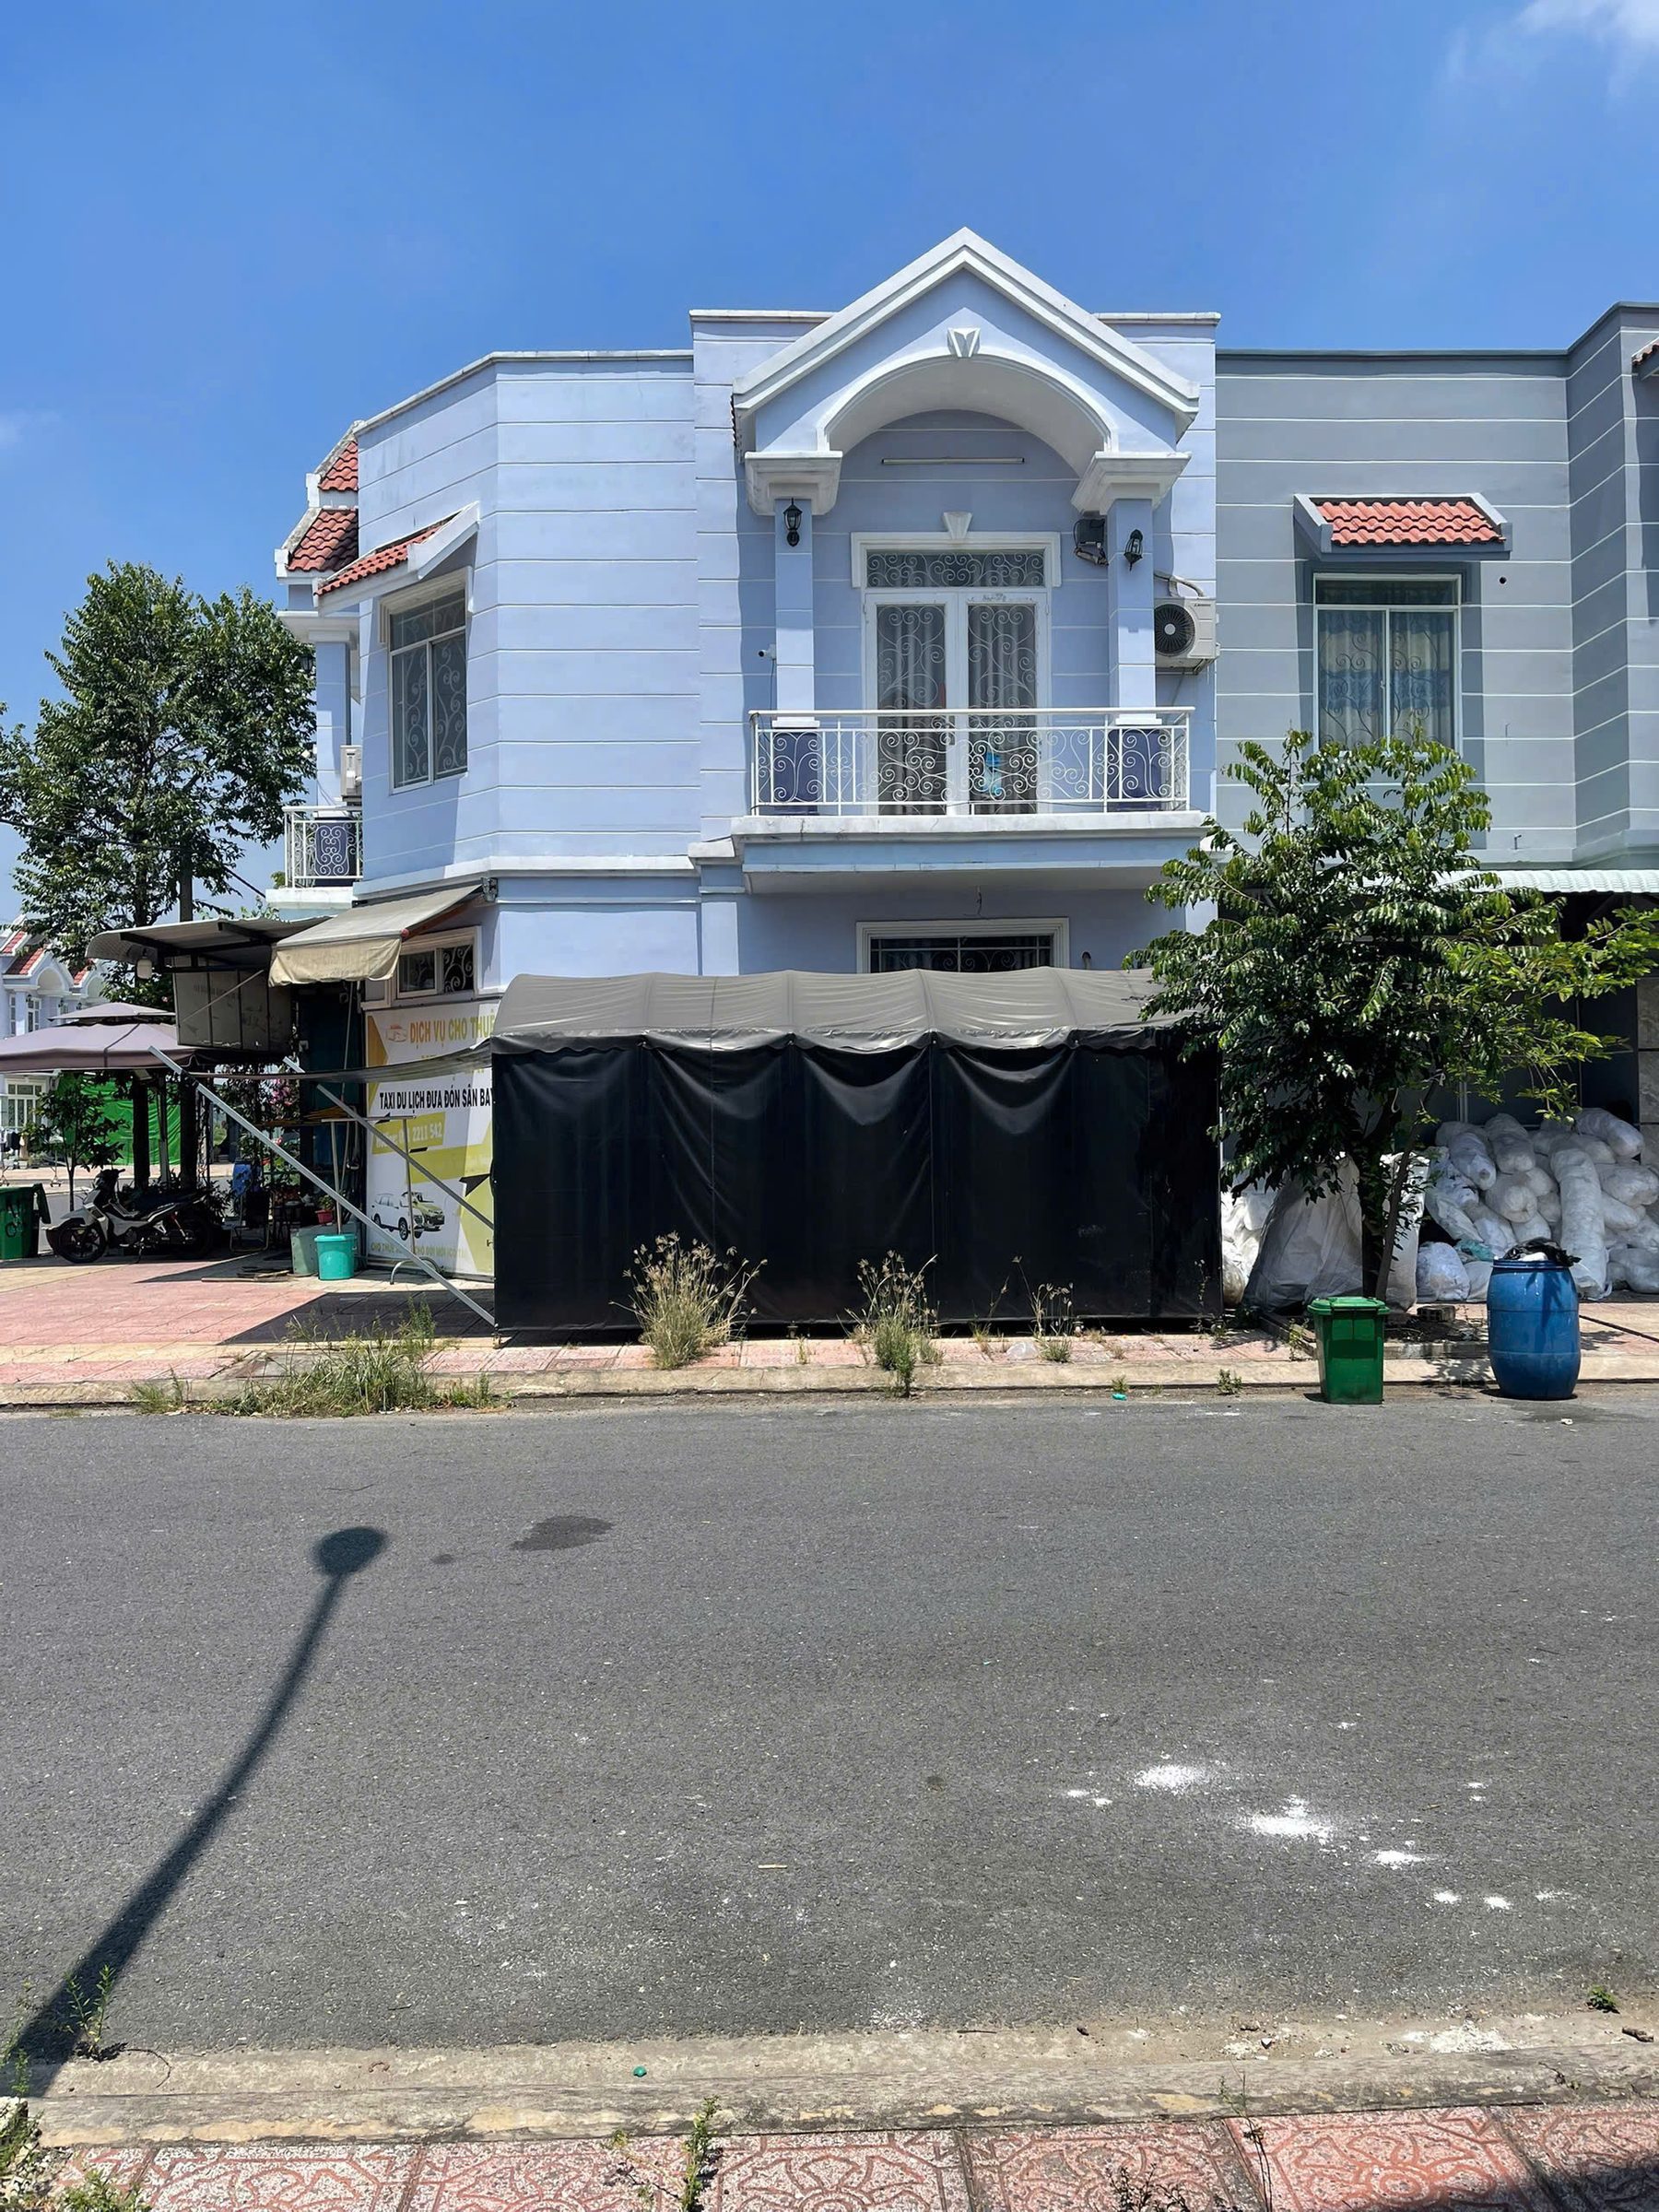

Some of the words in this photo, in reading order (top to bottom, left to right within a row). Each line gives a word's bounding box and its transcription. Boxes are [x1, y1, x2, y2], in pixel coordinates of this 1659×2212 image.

[410, 1020, 430, 1049] DỊCH
[433, 1019, 446, 1047] VỤ
[448, 1018, 467, 1041] CHO
[380, 1092, 395, 1110] TAXI
[396, 1091, 406, 1109] DU
[408, 1090, 425, 1113] LỊCH
[444, 1085, 460, 1109] ĐÓN
[462, 1084, 477, 1108] SÂN
[413, 1124, 428, 1142] 2211
[429, 1122, 442, 1139] 542
